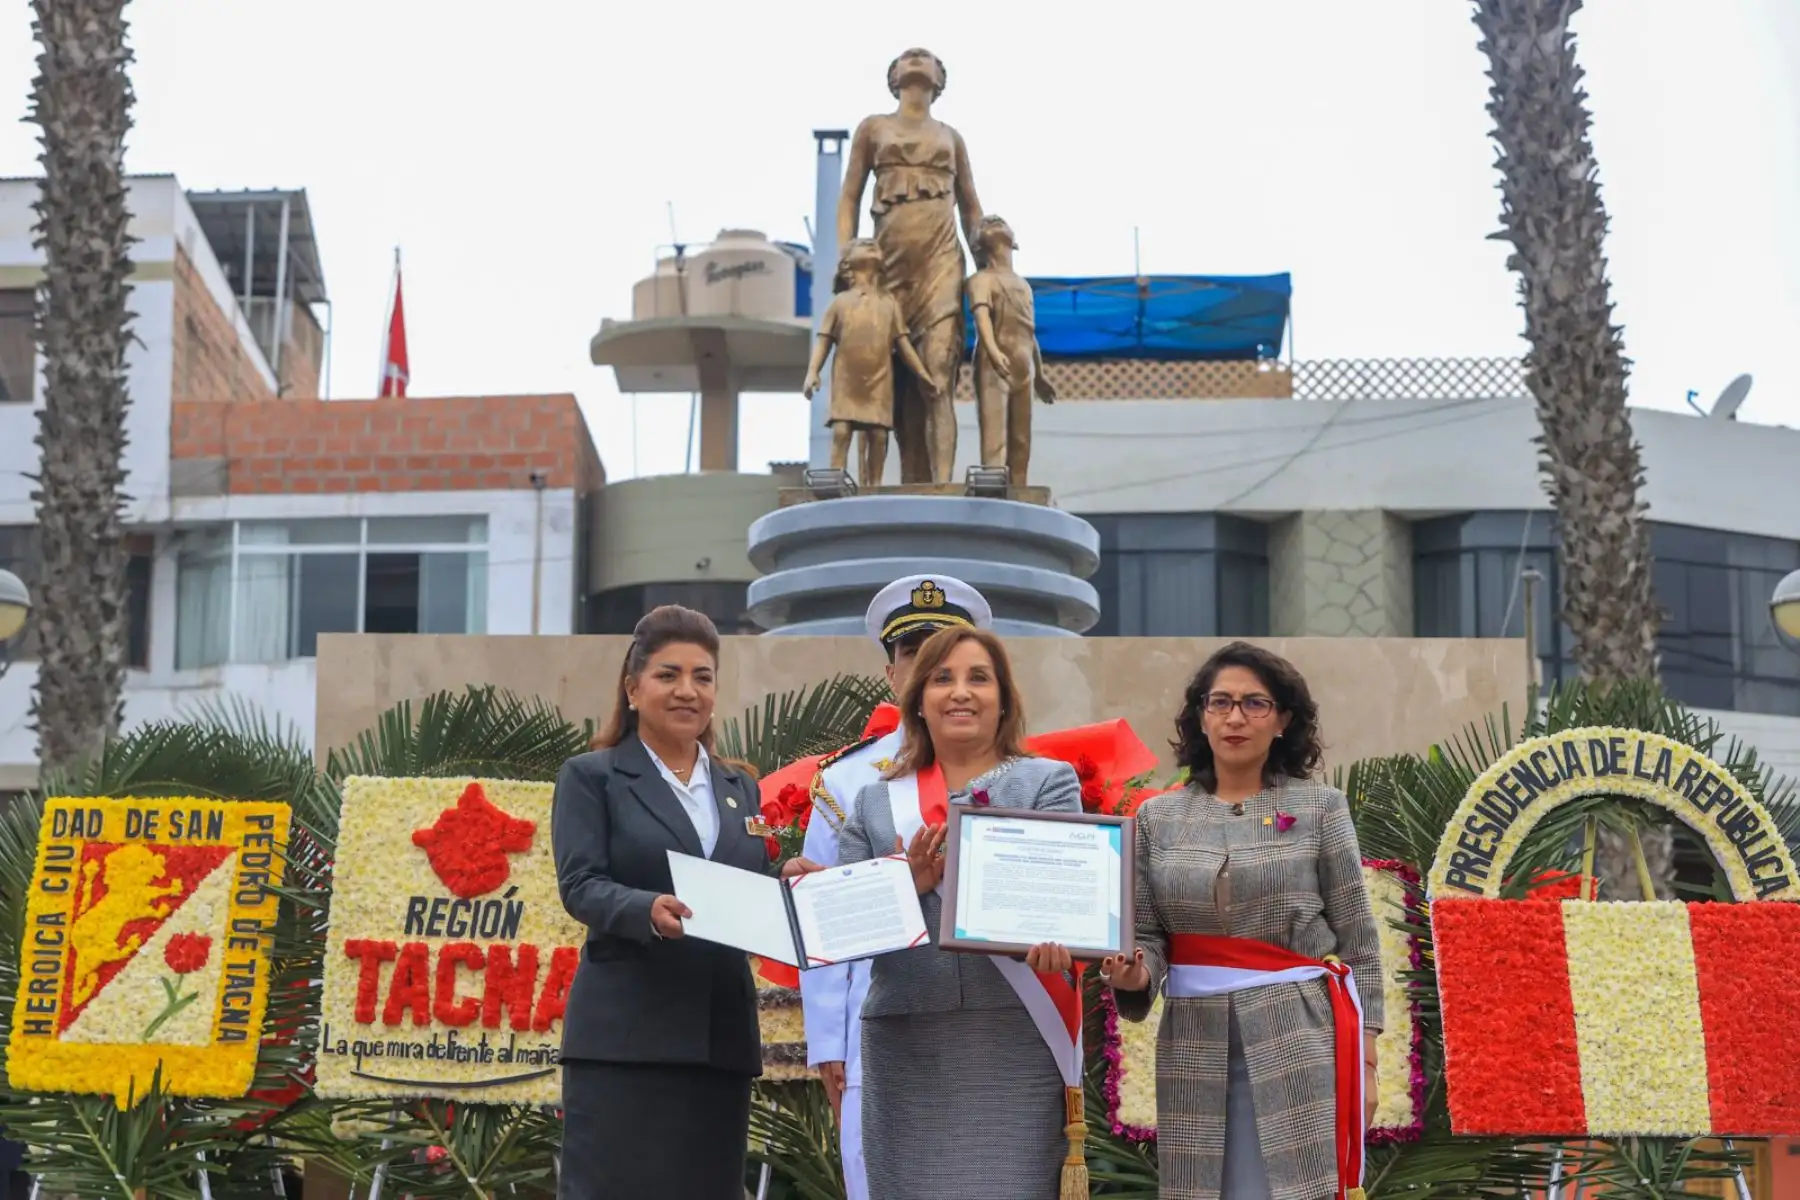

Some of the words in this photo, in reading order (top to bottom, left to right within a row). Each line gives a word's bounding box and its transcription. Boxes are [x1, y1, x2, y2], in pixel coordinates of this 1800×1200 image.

[52, 808, 104, 838] DAD
[125, 808, 160, 840] DE
[168, 809, 224, 841] SAN
[1445, 740, 1587, 894] PRESIDENCIA
[1588, 737, 1627, 777] DE
[1633, 740, 1673, 787] LA
[1673, 757, 1791, 897] REPUBLICA
[234, 814, 274, 907] PEDRO
[228, 918, 262, 951] DE
[404, 885, 525, 939] REGIÓN
[22, 911, 67, 1036] HEROICA
[216, 958, 256, 1042] TACNA
[344, 938, 580, 1032] TACNA
[322, 1022, 348, 1056] La
[351, 1040, 384, 1071] que
[387, 1038, 423, 1060] mira
[427, 1033, 446, 1059] de
[497, 1033, 515, 1063] al
[516, 1043, 561, 1065] maña
